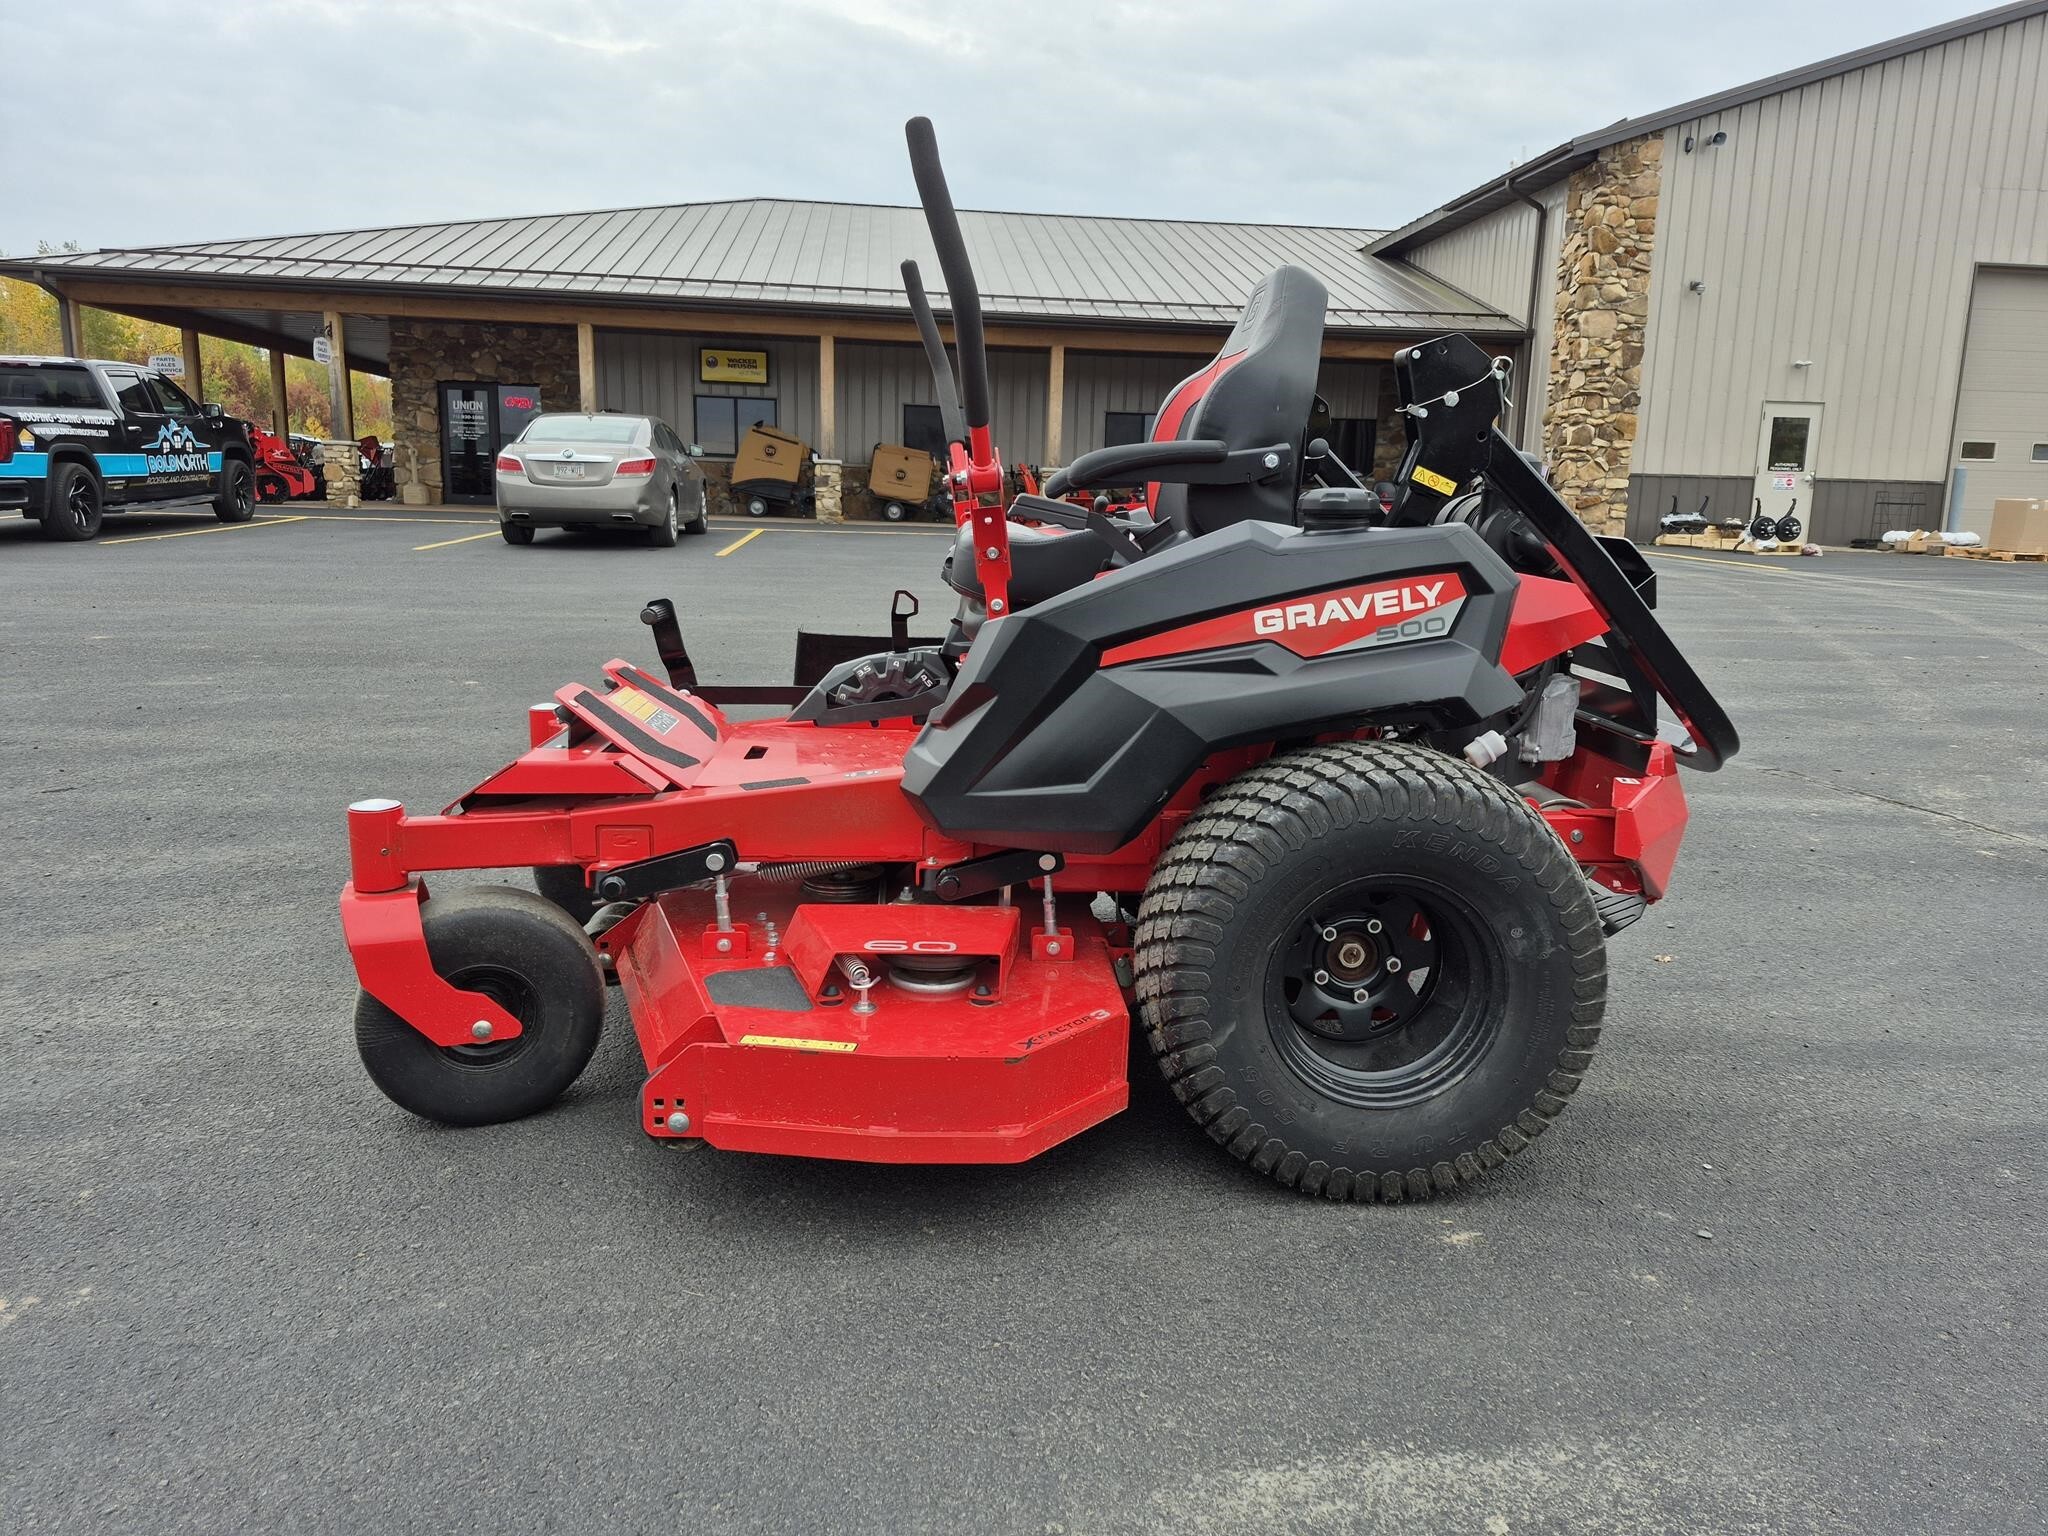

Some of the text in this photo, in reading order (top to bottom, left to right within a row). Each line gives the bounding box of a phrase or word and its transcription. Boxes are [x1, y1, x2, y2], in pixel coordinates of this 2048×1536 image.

[453, 400, 484, 411] UNION
[504, 397, 534, 409] OPEN
[1253, 581, 1445, 635] GRAVELY
[1376, 616, 1446, 642] 500
[892, 660, 901, 668] 4
[856, 665, 872, 677] 3.5
[921, 674, 934, 688] 4.5
[1391, 830, 1522, 894] KENDA
[863, 939, 957, 952] 60
